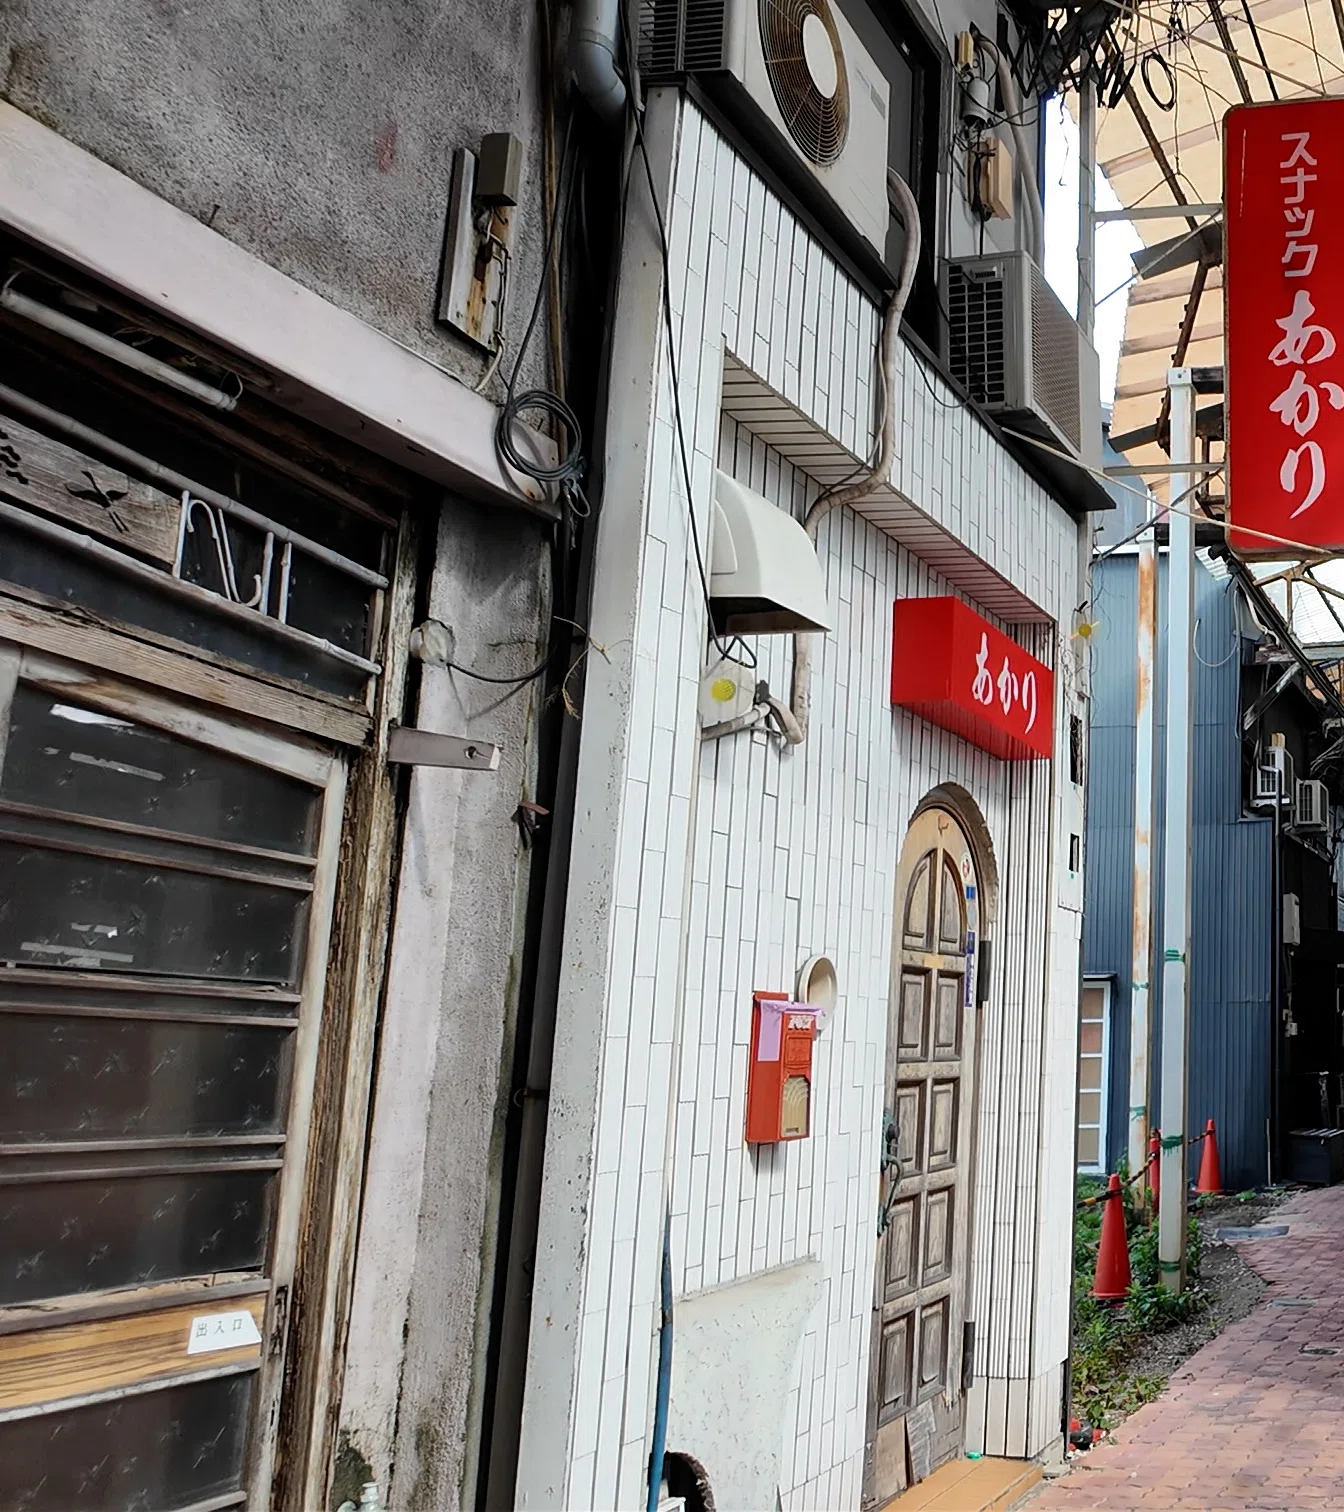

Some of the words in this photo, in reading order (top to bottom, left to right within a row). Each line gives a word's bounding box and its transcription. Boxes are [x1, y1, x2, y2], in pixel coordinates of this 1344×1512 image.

[1280, 130, 1318, 278] スナック
[972, 631, 1037, 735] あかり
[195, 1318, 244, 1338] 出入口
